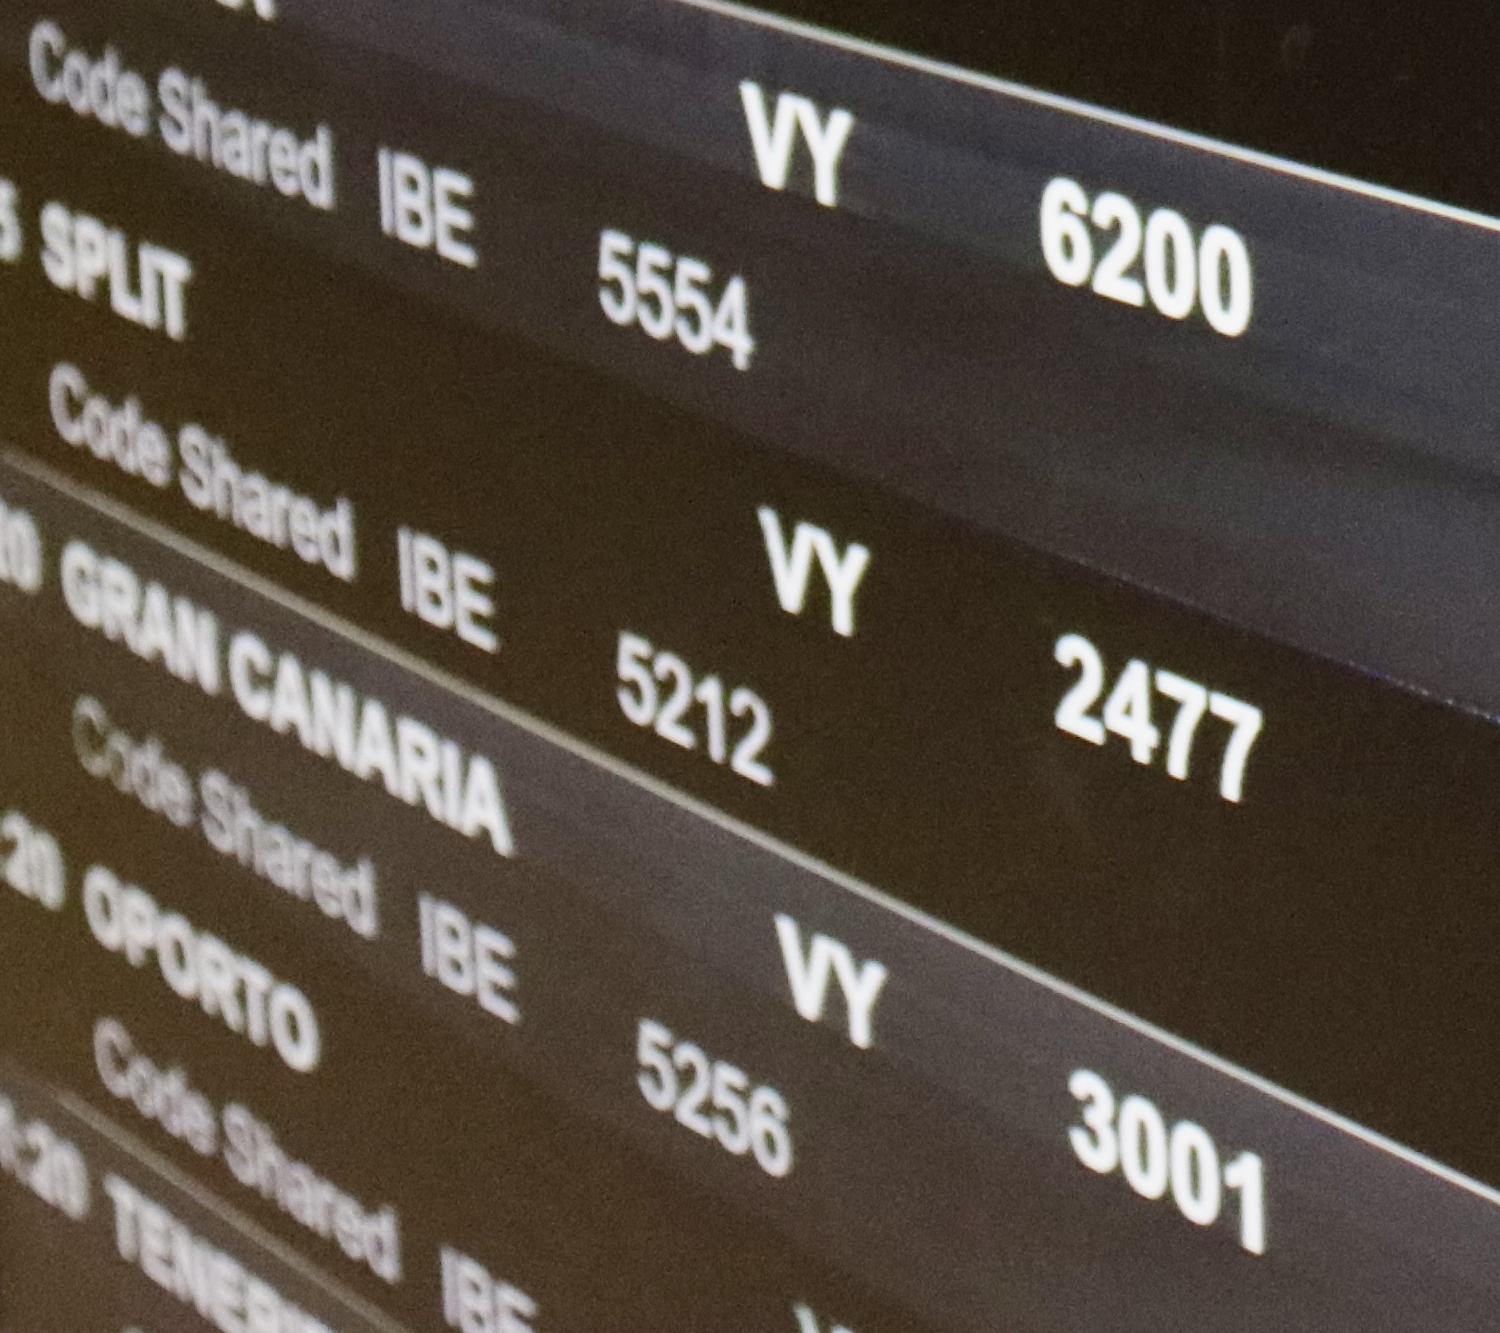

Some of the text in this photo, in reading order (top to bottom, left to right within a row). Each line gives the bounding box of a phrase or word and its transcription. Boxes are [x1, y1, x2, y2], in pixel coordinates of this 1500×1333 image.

[30, 22, 753, 365] Code Shared IBE 5554
[740, 81, 853, 206] VY
[1040, 177, 1252, 337] 6200
[41, 204, 191, 338] SPLIT
[759, 509, 869, 636] VY
[1055, 634, 1262, 802] 2477
[50, 365, 772, 785] Code Shared IBE 5212
[62, 543, 220, 693] GRAN
[229, 634, 512, 855] CANARIA
[776, 915, 886, 1047] VY
[1069, 1070, 1264, 1254] 3001
[77, 699, 791, 1177] Code Shared IBE 5256
[84, 868, 318, 1071] OPORTO
[94, 1020, 215, 1154] Code
[224, 1105, 400, 1282] Shared
